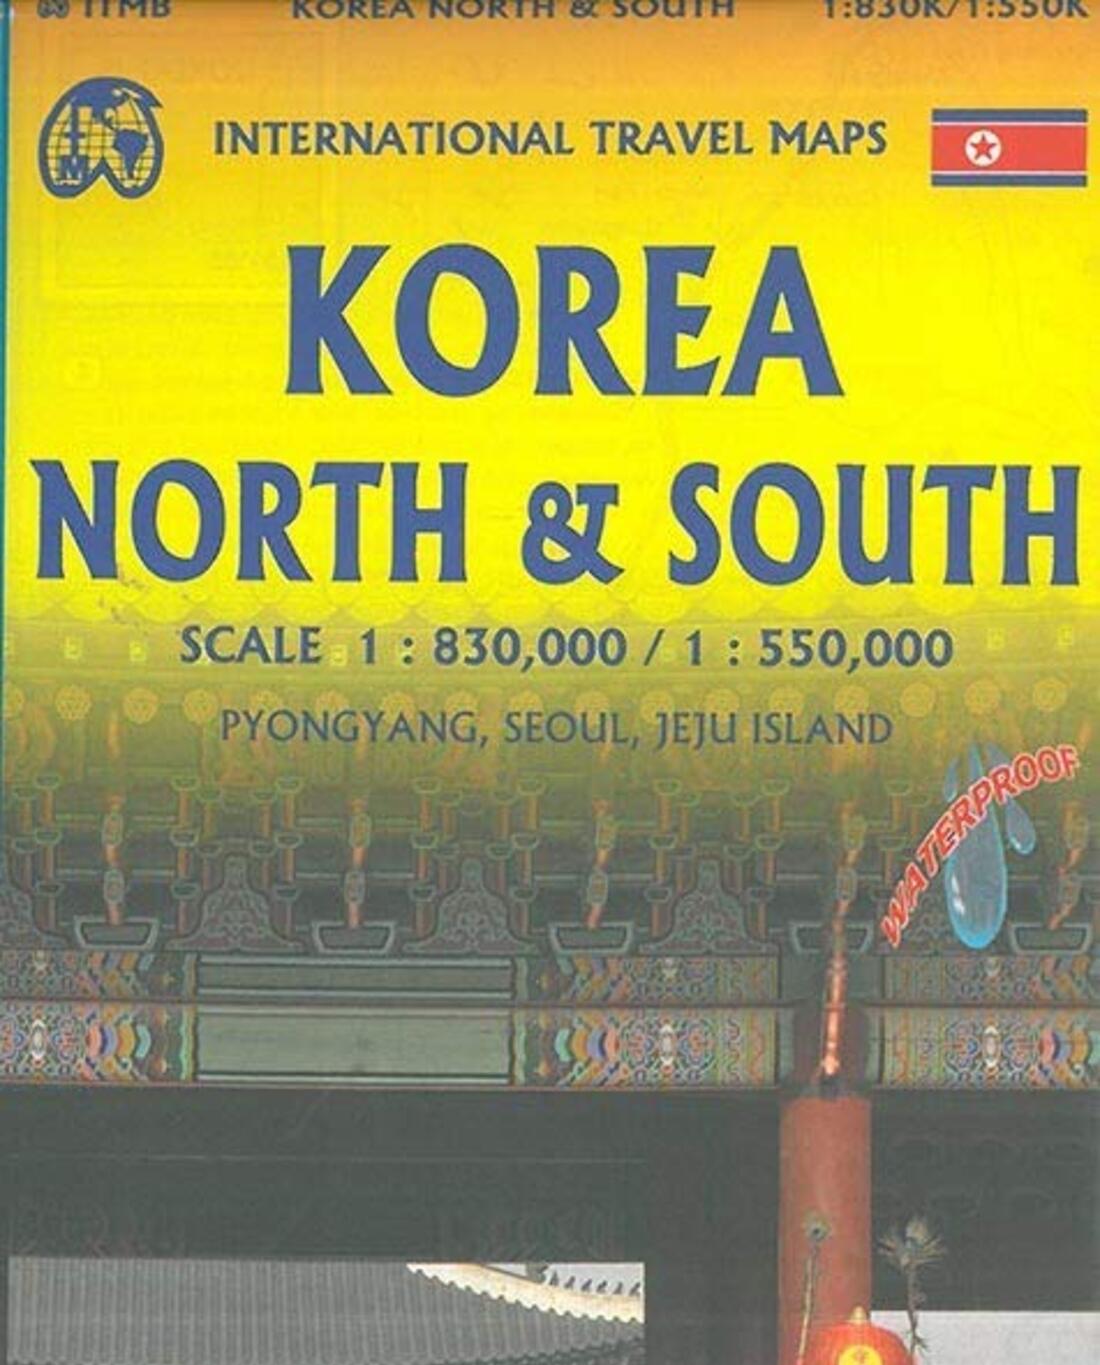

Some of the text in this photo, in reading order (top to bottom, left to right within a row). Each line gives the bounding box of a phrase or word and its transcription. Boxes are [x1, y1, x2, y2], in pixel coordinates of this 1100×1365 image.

[291, 0, 735, 19] KOREA NORTH & SOUTH
[214, 119, 887, 156] INTERNATIONAL TRAVEL MAPS
[284, 242, 846, 399] KOREA
[28, 458, 1081, 587] NORTH & SOUTH
[179, 624, 955, 675] SCALE 1 : 830,000 / 1 : 550,000
[221, 708, 894, 750] PYONGYANG, SEOUL, JEJU ISLAND
[880, 744, 1080, 949] WATERPROOF
